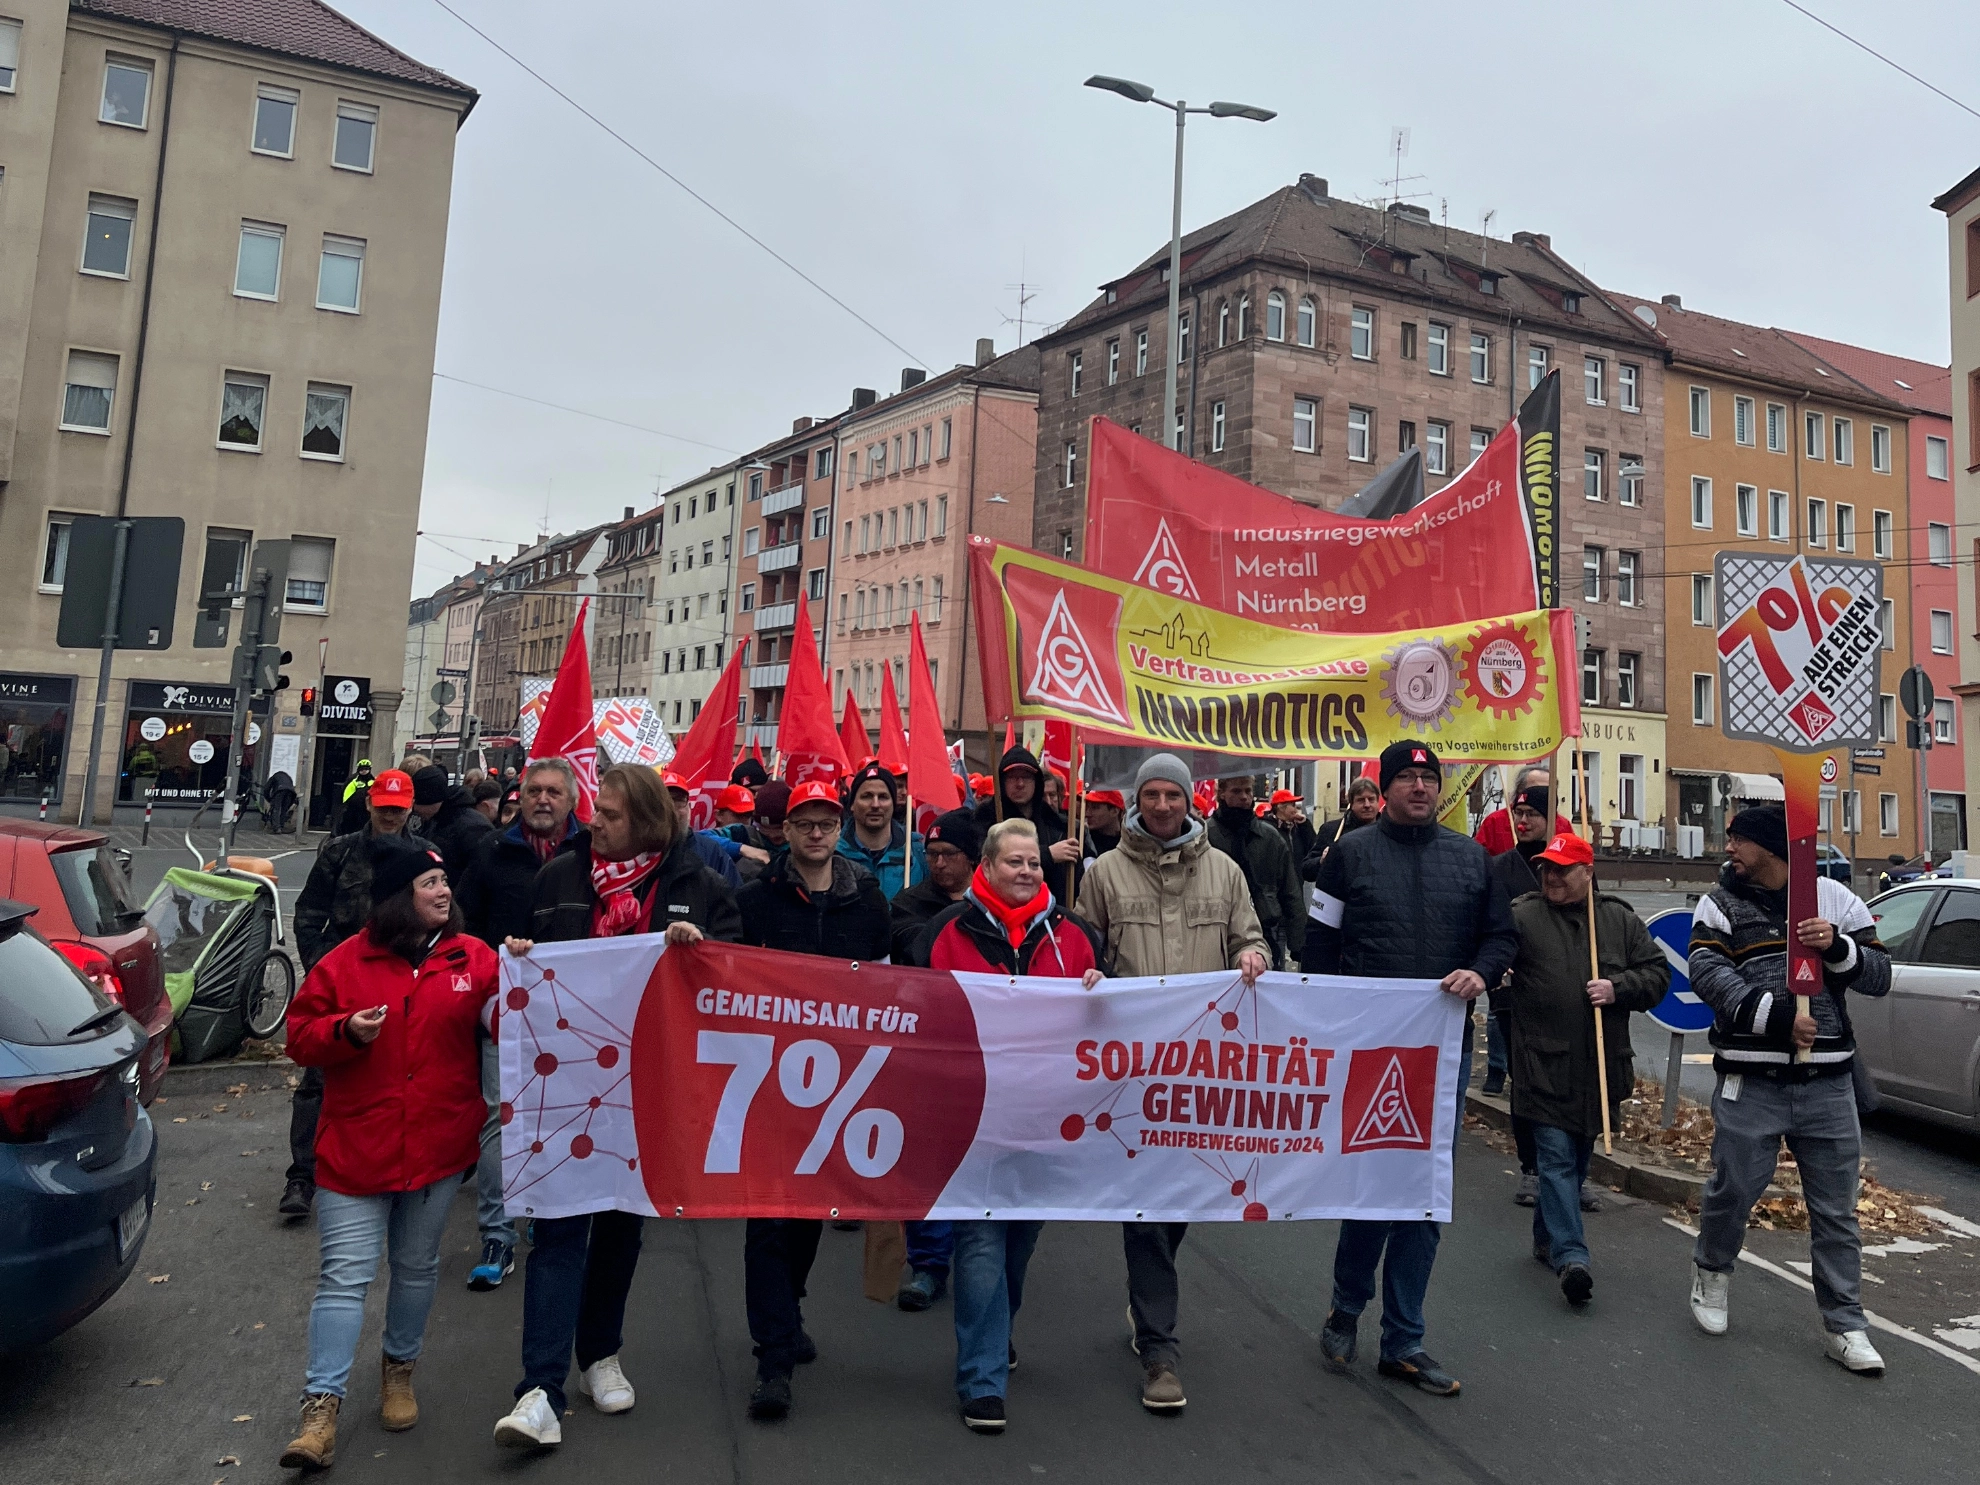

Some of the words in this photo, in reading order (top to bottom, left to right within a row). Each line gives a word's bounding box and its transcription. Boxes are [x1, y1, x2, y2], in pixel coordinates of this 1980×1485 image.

[1234, 479, 1503, 546] Industriegewerkschaft
[1235, 552, 1318, 578] Metall
[1237, 588, 1366, 615] Nürnberg
[1718, 561, 1853, 696] 7%
[1802, 644, 1834, 685] AUF
[1827, 595, 1875, 648] EINEN
[1128, 643, 1369, 686] Vertrauensleute
[1481, 657, 1522, 669] Nürnberg
[1817, 624, 1879, 698] STREICH
[189, 694, 232, 706] DIVIN
[321, 705, 367, 720] DIVINE
[1135, 684, 1369, 750] INNOMOTICS
[1445, 736, 1551, 753] Vogelweiherstraße
[1822, 763, 1834, 775] 30
[144, 788, 160, 797] MIT
[161, 788, 178, 797] UND
[180, 789, 201, 798] OHNE
[696, 987, 859, 1030] GEMEINSAM
[865, 1005, 919, 1034] FÜR
[1075, 1036, 1335, 1087] SOLIDARITÄT
[696, 1030, 905, 1178] 7%
[1142, 1082, 1330, 1131] GEWINNT
[1139, 1129, 1280, 1154] TARIFBEWEGUNG
[1282, 1136, 1325, 1154] 2024
